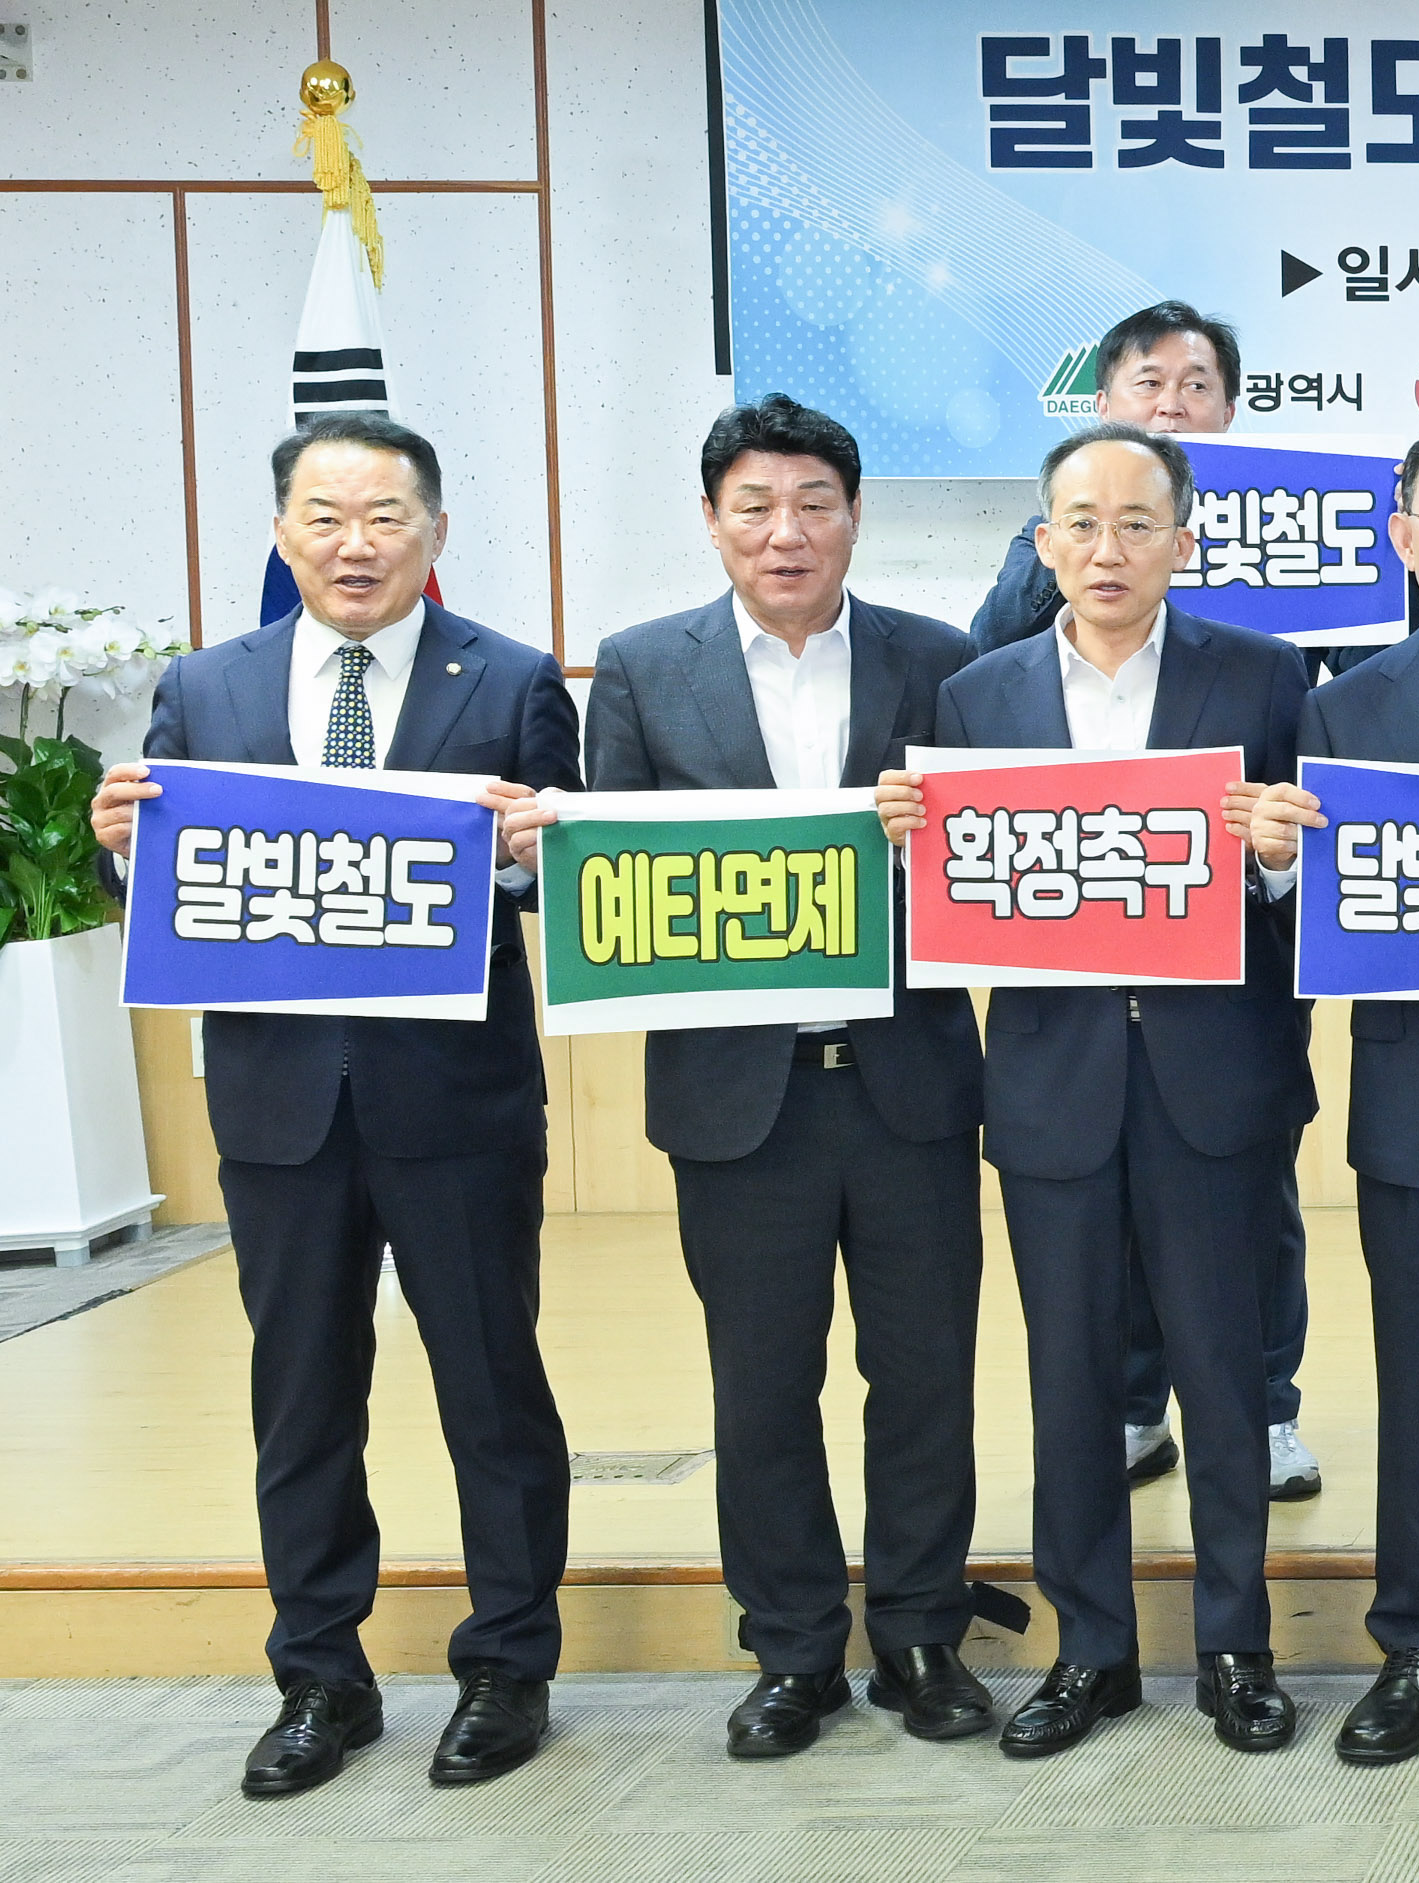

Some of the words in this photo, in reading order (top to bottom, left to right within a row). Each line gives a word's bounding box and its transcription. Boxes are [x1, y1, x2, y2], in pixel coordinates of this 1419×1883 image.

[1246, 373, 1363, 412] 광역시
[172, 825, 456, 950] 달빛철도
[577, 844, 859, 968] 예타면제
[943, 805, 1212, 921] 확정촉구
